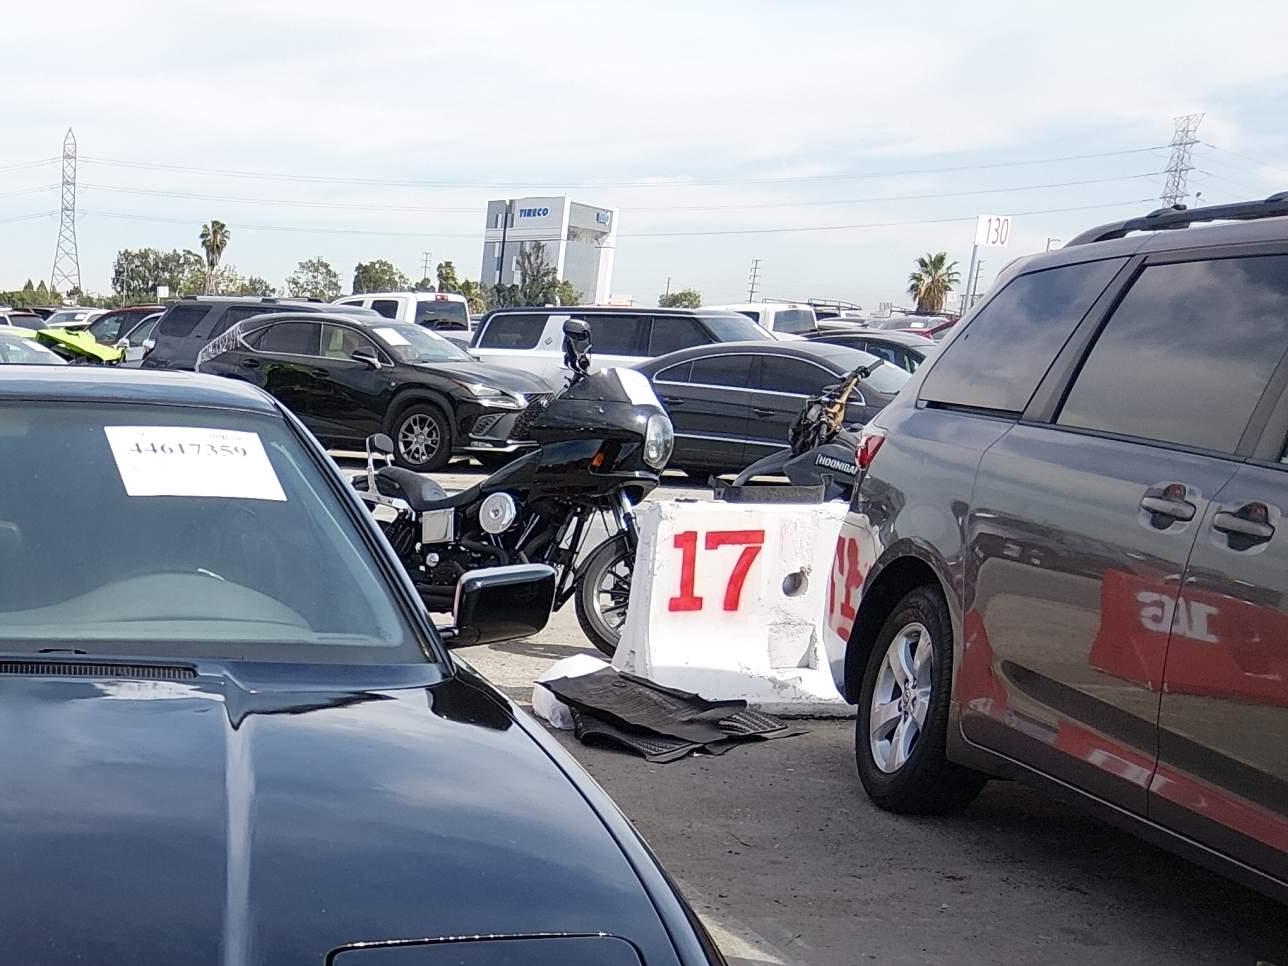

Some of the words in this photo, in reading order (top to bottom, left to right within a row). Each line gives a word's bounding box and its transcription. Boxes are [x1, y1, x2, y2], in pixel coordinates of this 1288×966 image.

[519, 207, 550, 218] TIRECO
[986, 217, 1009, 245] 130
[129, 441, 248, 457] 44617359
[668, 529, 765, 612] 17
